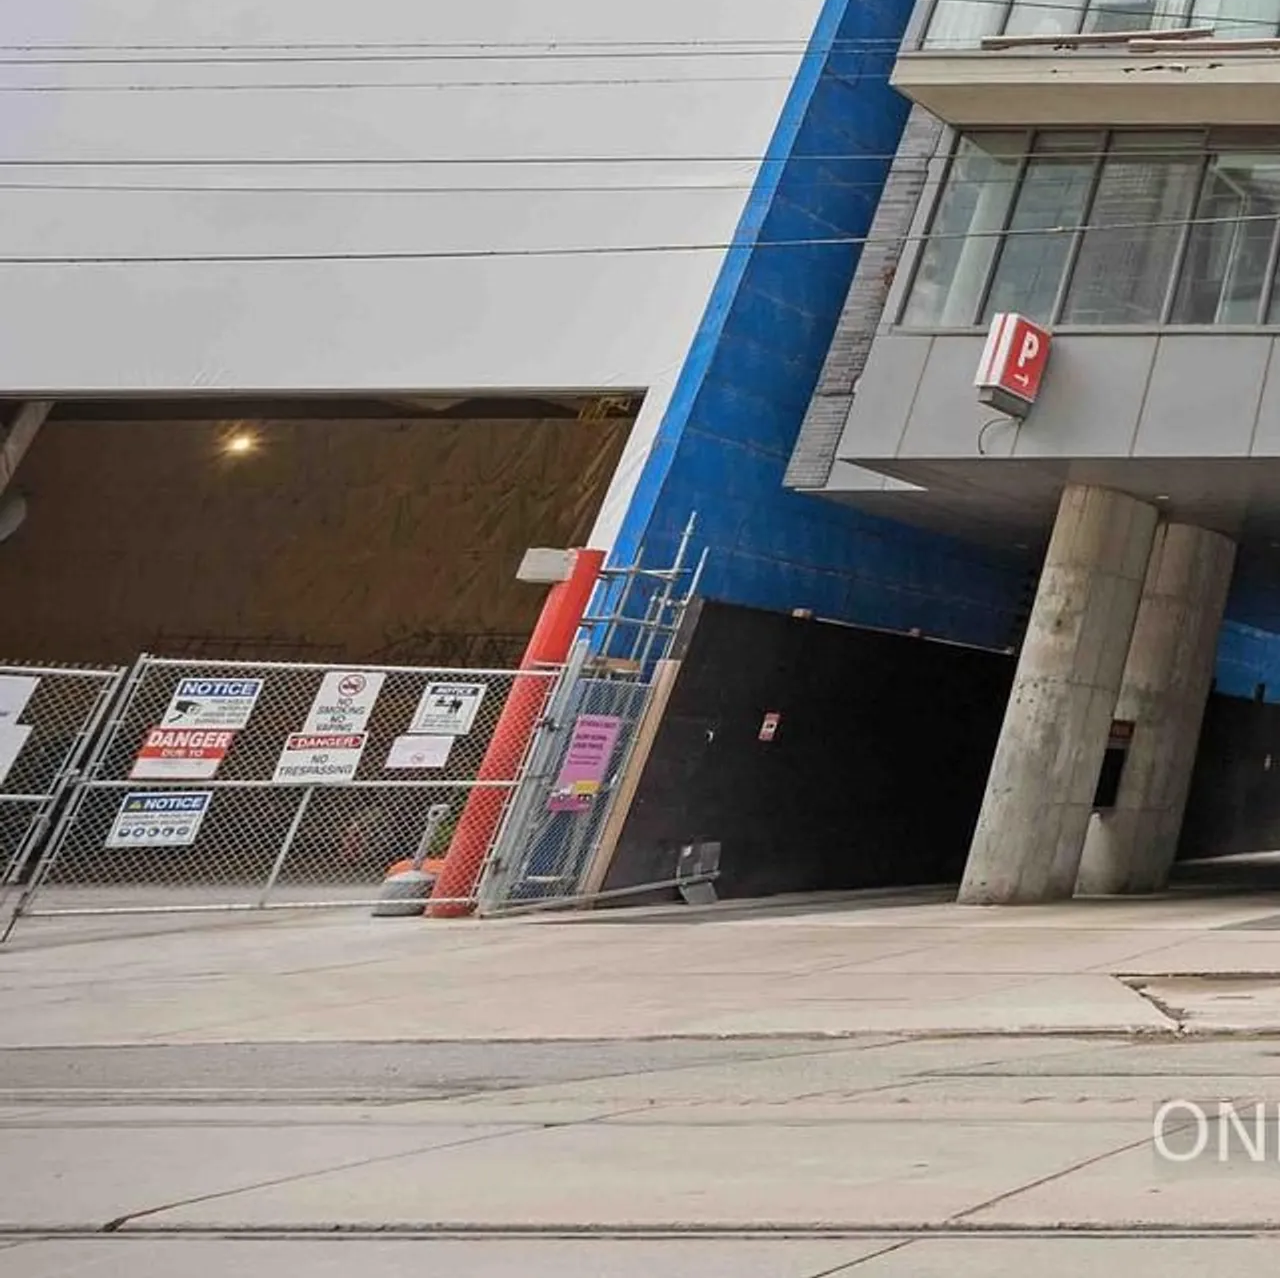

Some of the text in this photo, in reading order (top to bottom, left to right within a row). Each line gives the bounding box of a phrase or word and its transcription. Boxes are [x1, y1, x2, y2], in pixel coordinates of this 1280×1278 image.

[1017, 330, 1040, 368] P
[182, 681, 257, 696] NOTICE
[337, 698, 353, 706] NO
[316, 706, 365, 714] SMOKING
[330, 715, 346, 723] NO
[147, 731, 233, 748] DANGER
[297, 736, 354, 747] DANGER
[160, 748, 205, 757] DUE TO
[310, 754, 330, 763] NO
[279, 765, 354, 776] TRESPASSING
[143, 796, 204, 810] NOTICE
